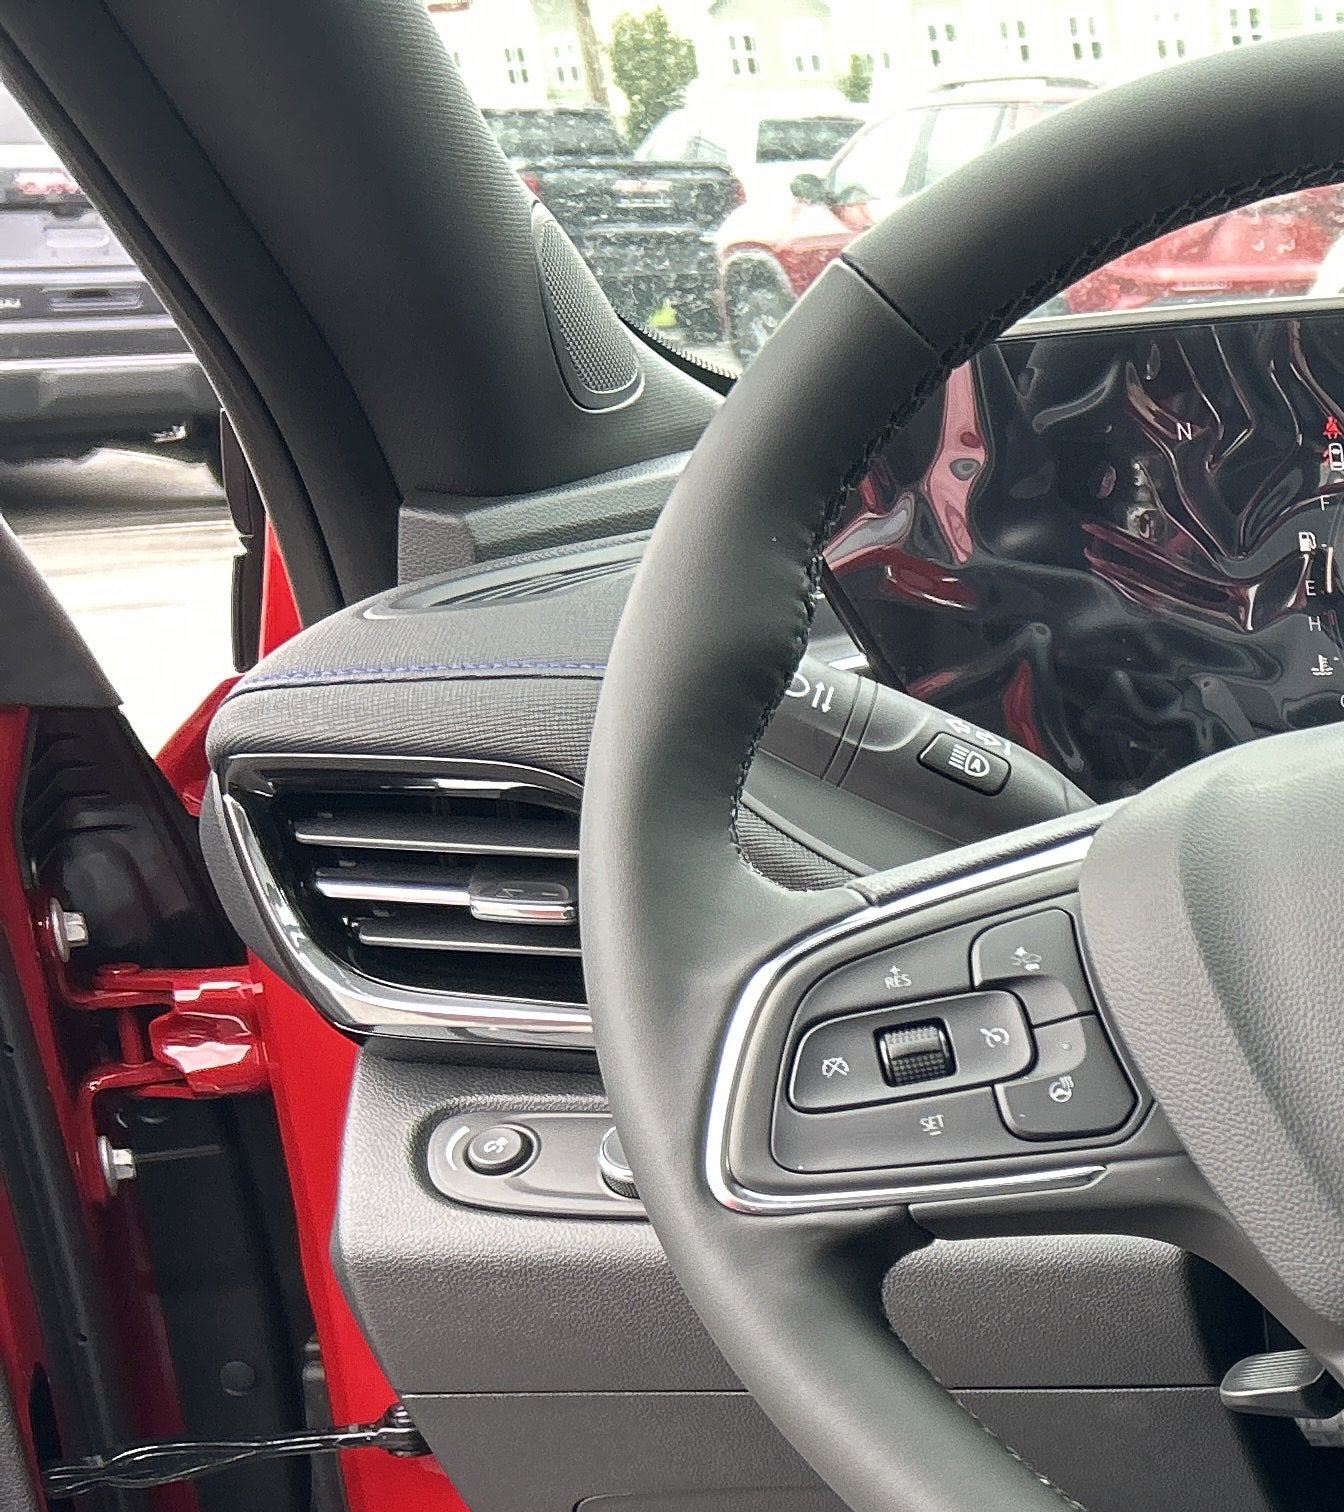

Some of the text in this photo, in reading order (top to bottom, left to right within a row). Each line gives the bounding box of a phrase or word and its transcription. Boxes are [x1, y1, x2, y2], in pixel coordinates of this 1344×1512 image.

[1321, 495, 1330, 511] F
[1305, 580, 1316, 596] E
[1308, 616, 1321, 632] H
[884, 974, 912, 990] RES
[920, 1114, 944, 1131] SET
